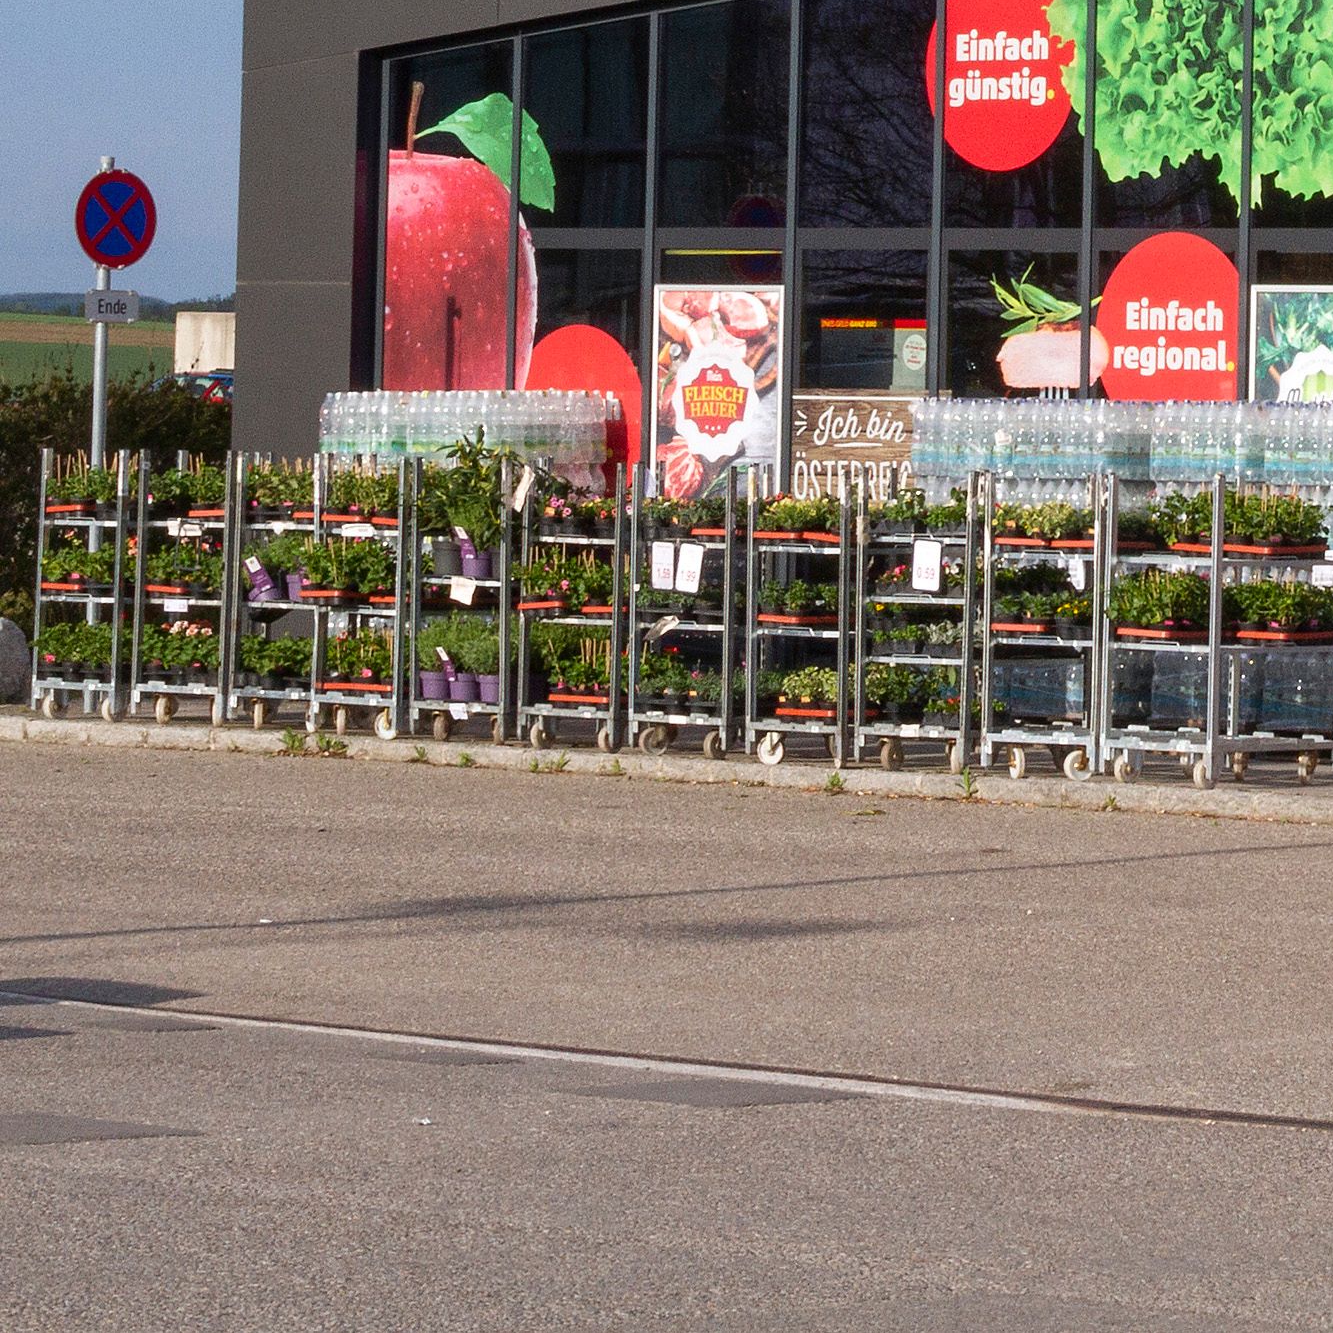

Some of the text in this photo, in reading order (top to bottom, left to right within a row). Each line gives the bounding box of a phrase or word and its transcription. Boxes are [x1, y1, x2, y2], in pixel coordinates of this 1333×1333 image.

[956, 28, 1049, 62] Einfach
[949, 66, 1056, 107] günstig.
[98, 298, 127, 315] Ende
[1125, 296, 1224, 332] Einfach
[1112, 336, 1235, 376] regional.
[684, 385, 745, 403] FLEISCH
[690, 401, 738, 419] HAUER
[813, 405, 907, 445] Ich bin
